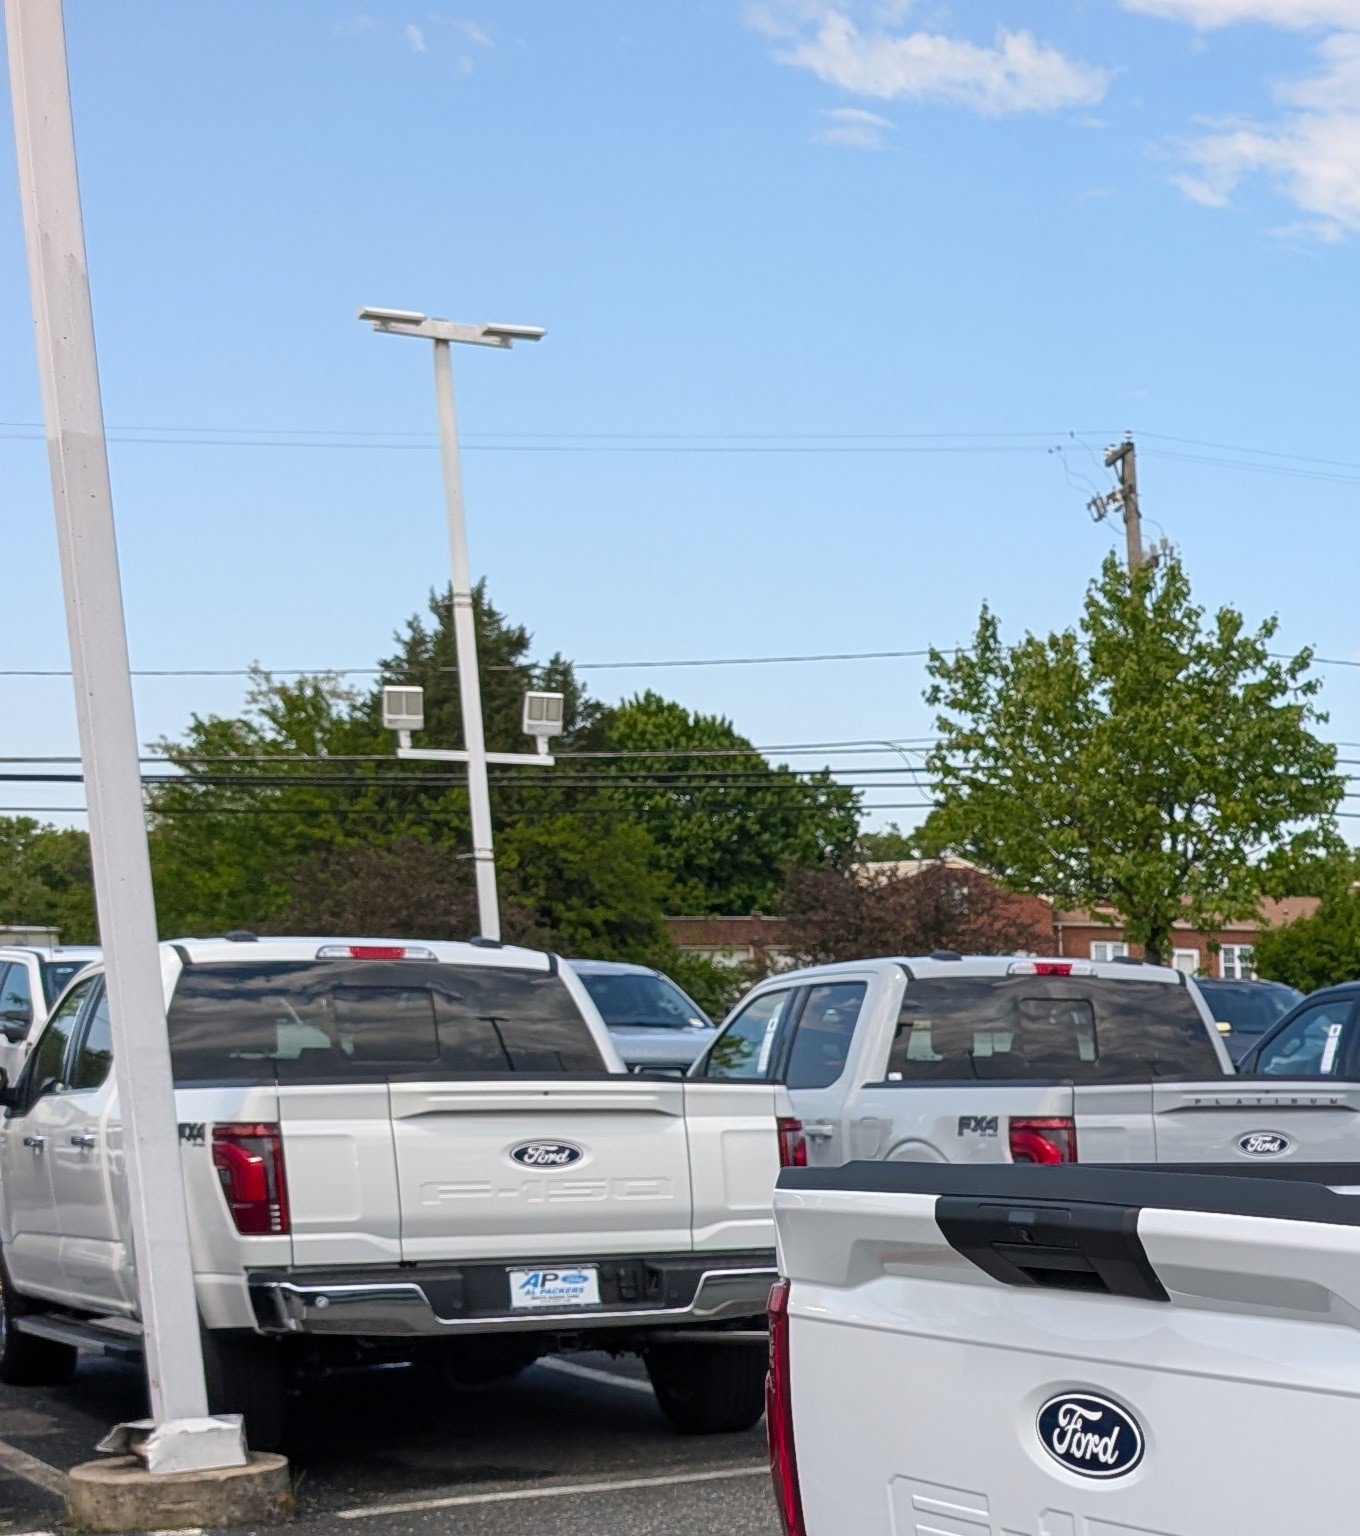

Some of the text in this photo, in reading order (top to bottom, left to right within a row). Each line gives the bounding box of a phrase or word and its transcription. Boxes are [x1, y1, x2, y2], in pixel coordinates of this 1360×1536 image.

[1194, 1097, 1338, 1105] PLATINUM
[957, 1115, 999, 1137] FX4
[523, 1144, 570, 1164] Ford
[1246, 1136, 1281, 1152] Ford
[419, 1176, 674, 1206] F-150
[518, 1272, 559, 1289] AP
[1052, 1403, 1120, 1465] Ford
